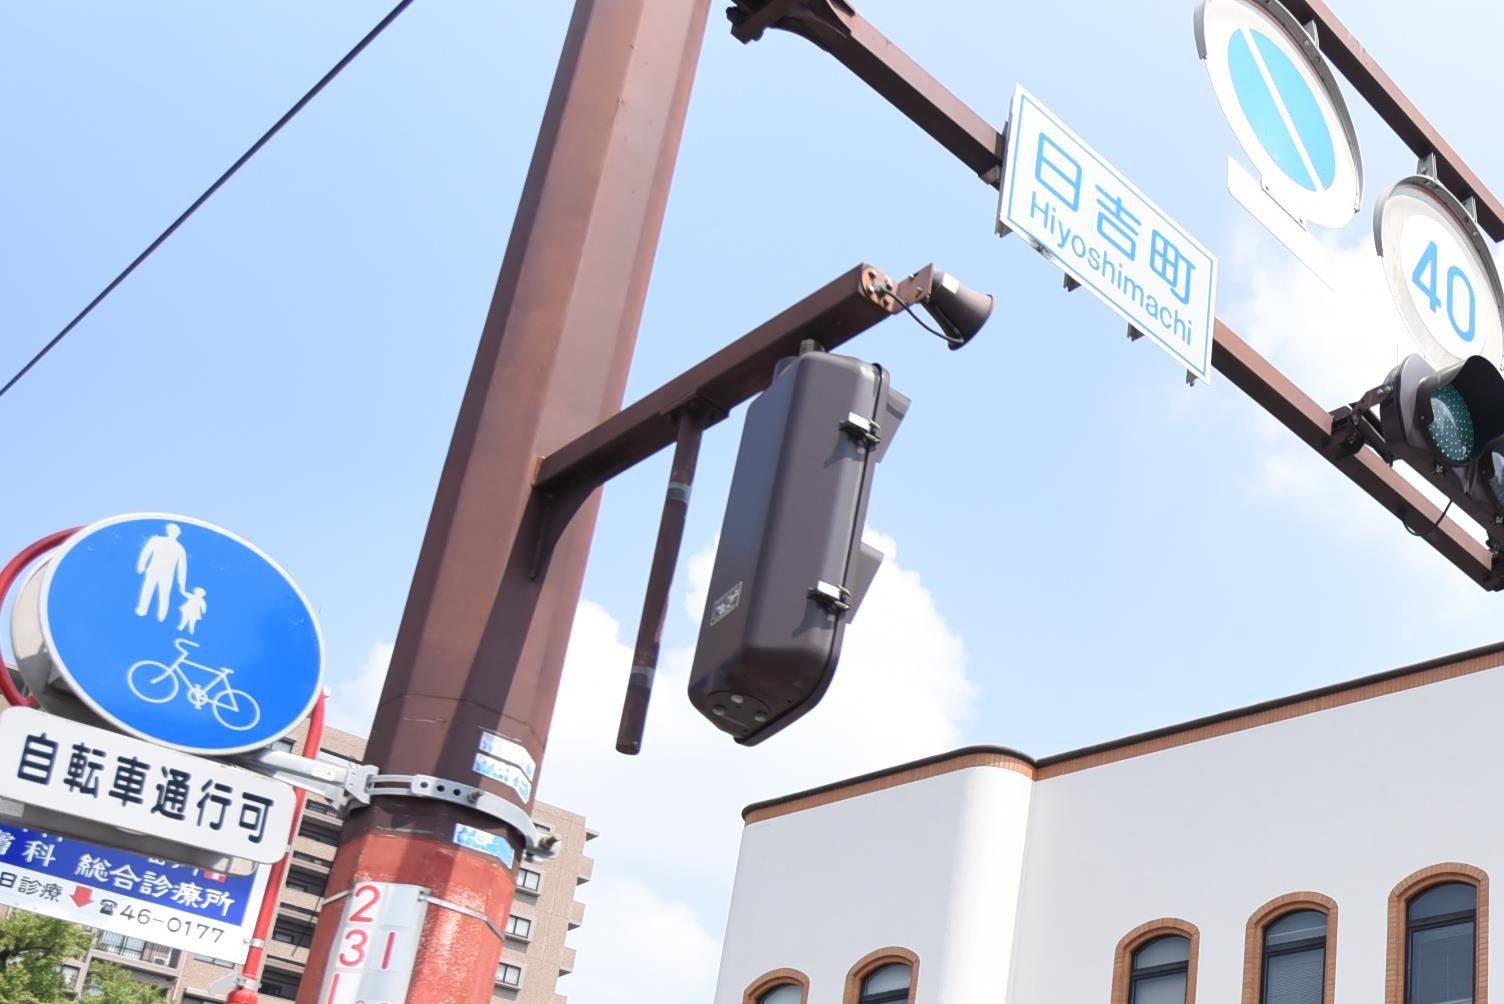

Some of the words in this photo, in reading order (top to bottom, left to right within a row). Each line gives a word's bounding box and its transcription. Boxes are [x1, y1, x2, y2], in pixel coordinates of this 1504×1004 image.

[1030, 191, 1193, 347] Hiyoshimachi
[1036, 132, 1196, 305] 日吉町
[1411, 242, 1476, 343] 40
[17, 733, 275, 844] 自転車通行可
[74, 853, 235, 918] 総合診療所
[120, 905, 225, 943] 46-0177
